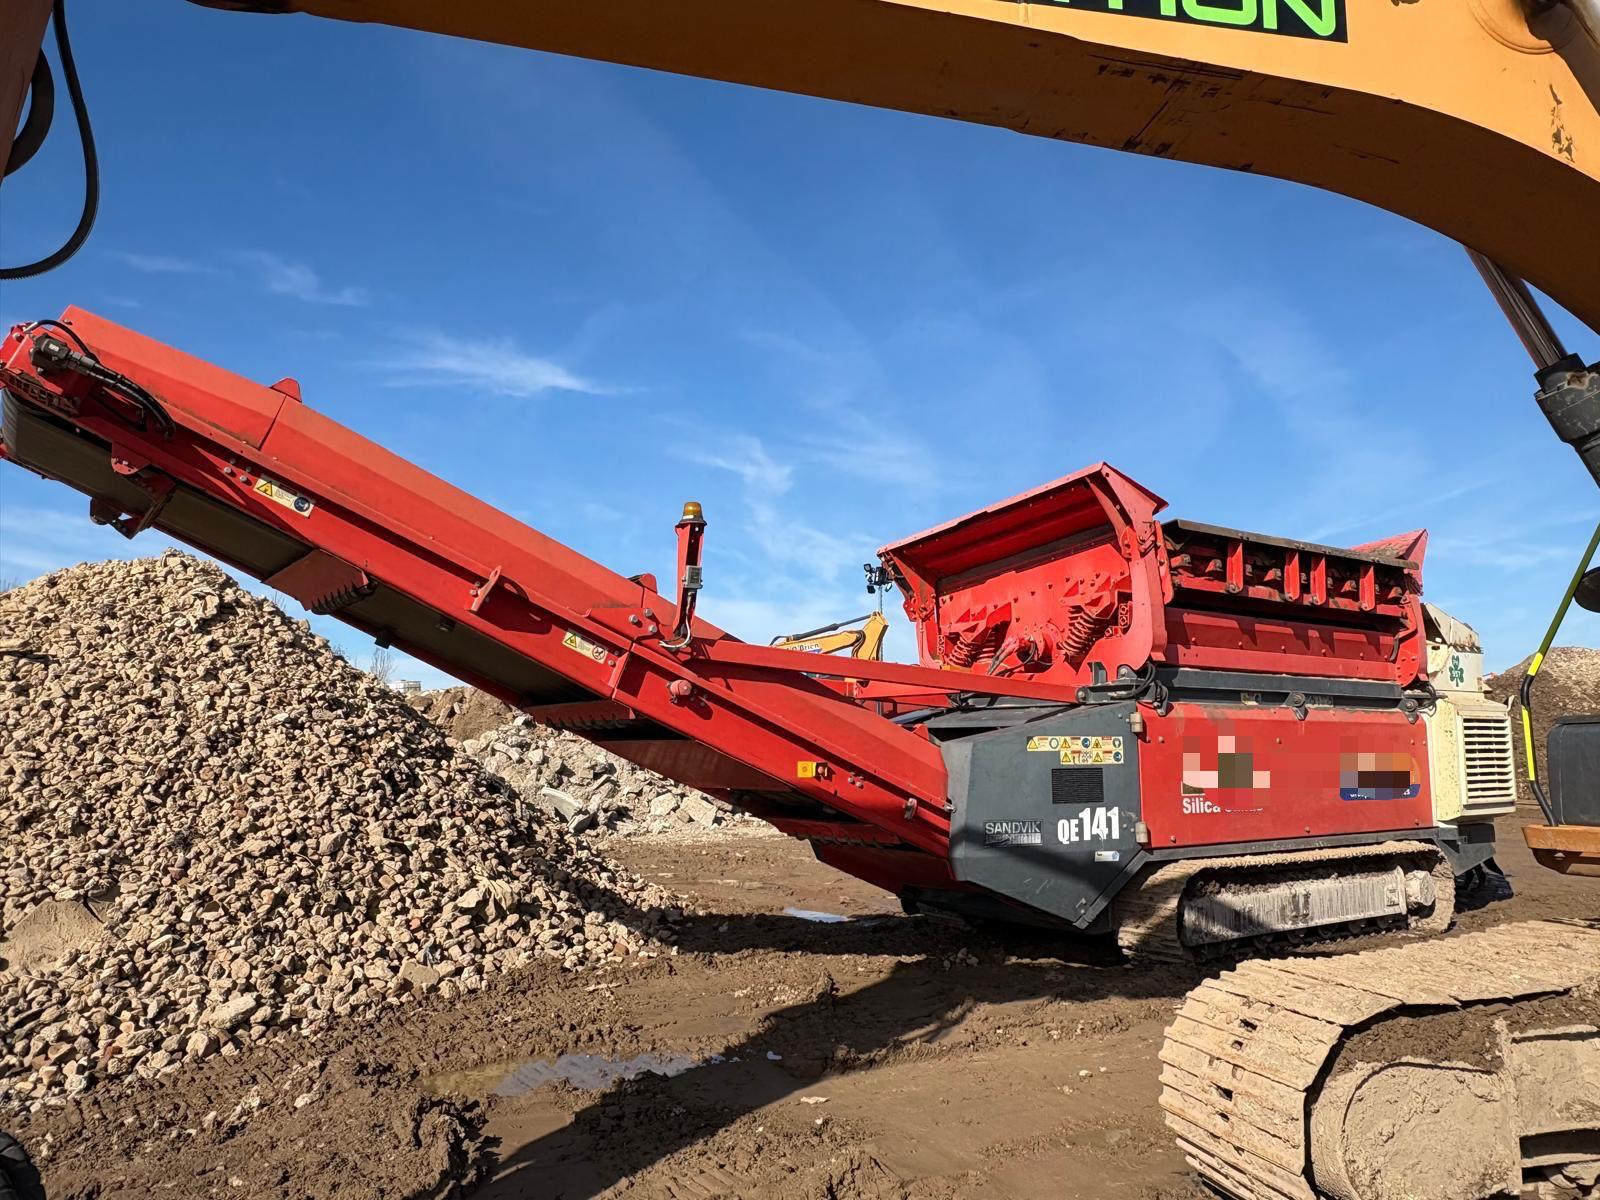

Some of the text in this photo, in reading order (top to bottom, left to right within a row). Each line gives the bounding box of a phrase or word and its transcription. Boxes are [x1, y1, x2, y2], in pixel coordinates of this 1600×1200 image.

[1182, 797, 1222, 814] Silica
[985, 820, 1041, 834] SANDVIK
[1057, 806, 1120, 845] QE141
